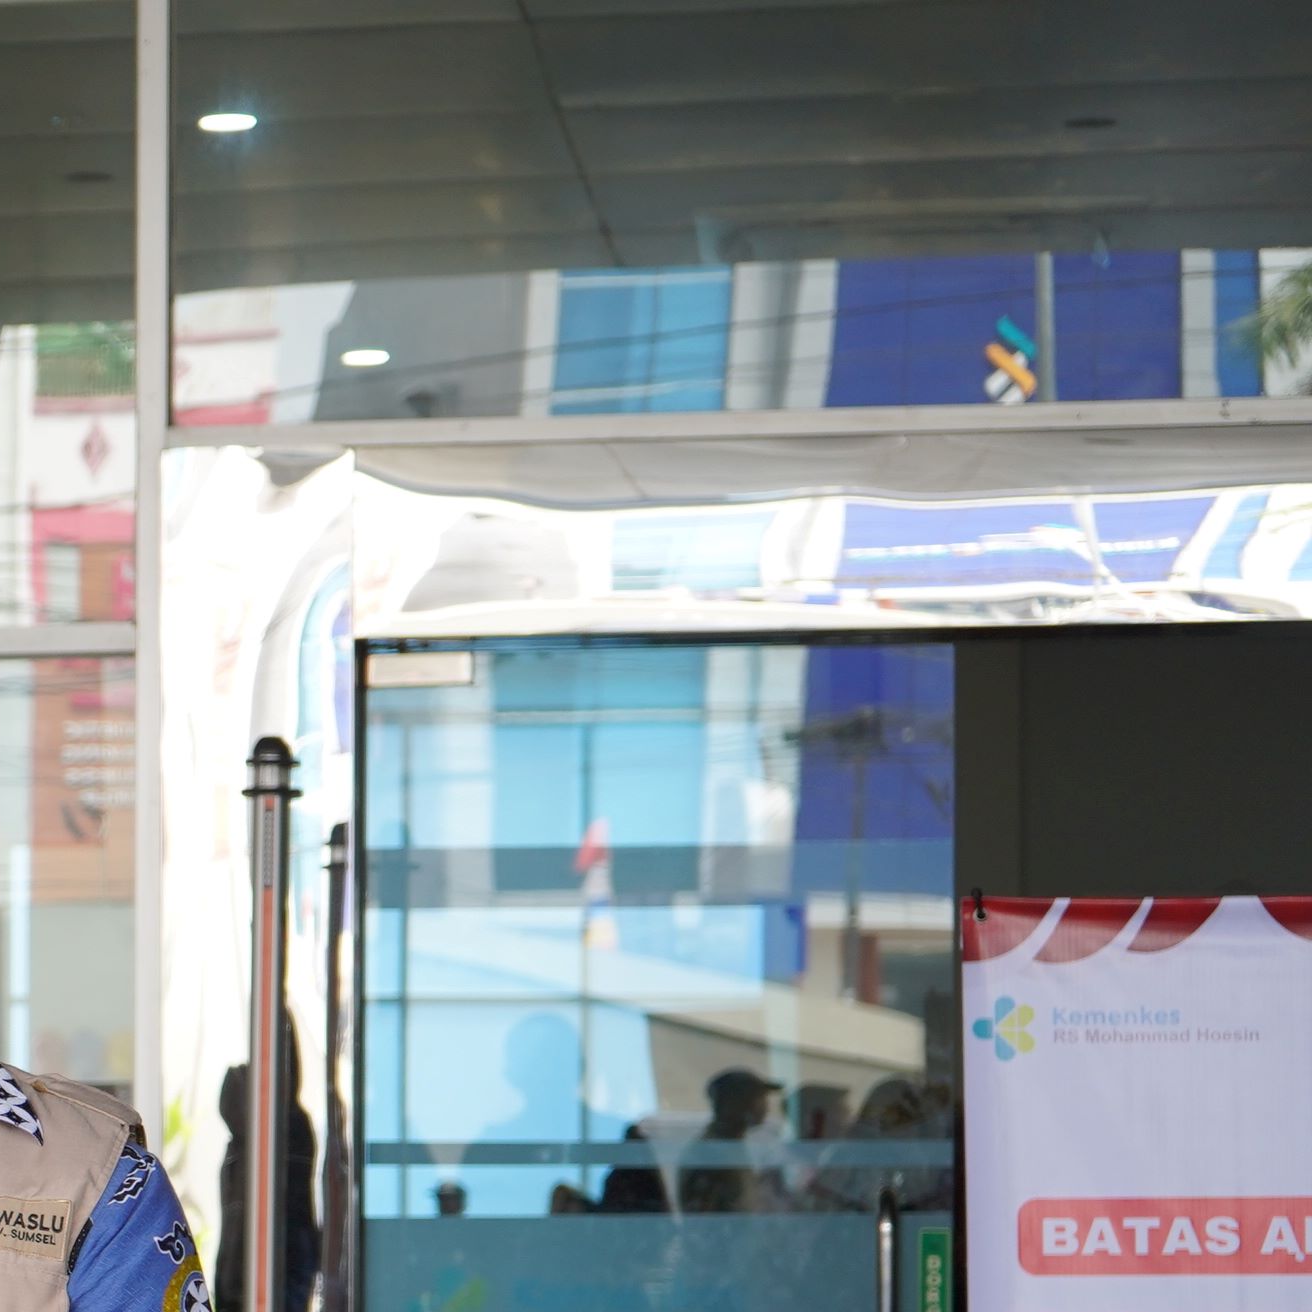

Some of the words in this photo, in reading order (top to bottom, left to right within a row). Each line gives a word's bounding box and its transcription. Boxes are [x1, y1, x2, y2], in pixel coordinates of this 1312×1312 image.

[1052, 1006, 1181, 1025] Kemenkes
[1053, 1028, 1079, 1044] RS
[1085, 1026, 1190, 1044] Mohammad
[1197, 1026, 1260, 1042] Hoesin
[10, 1229, 56, 1245] SUMSEL
[1041, 1216, 1240, 1256] BATAS
